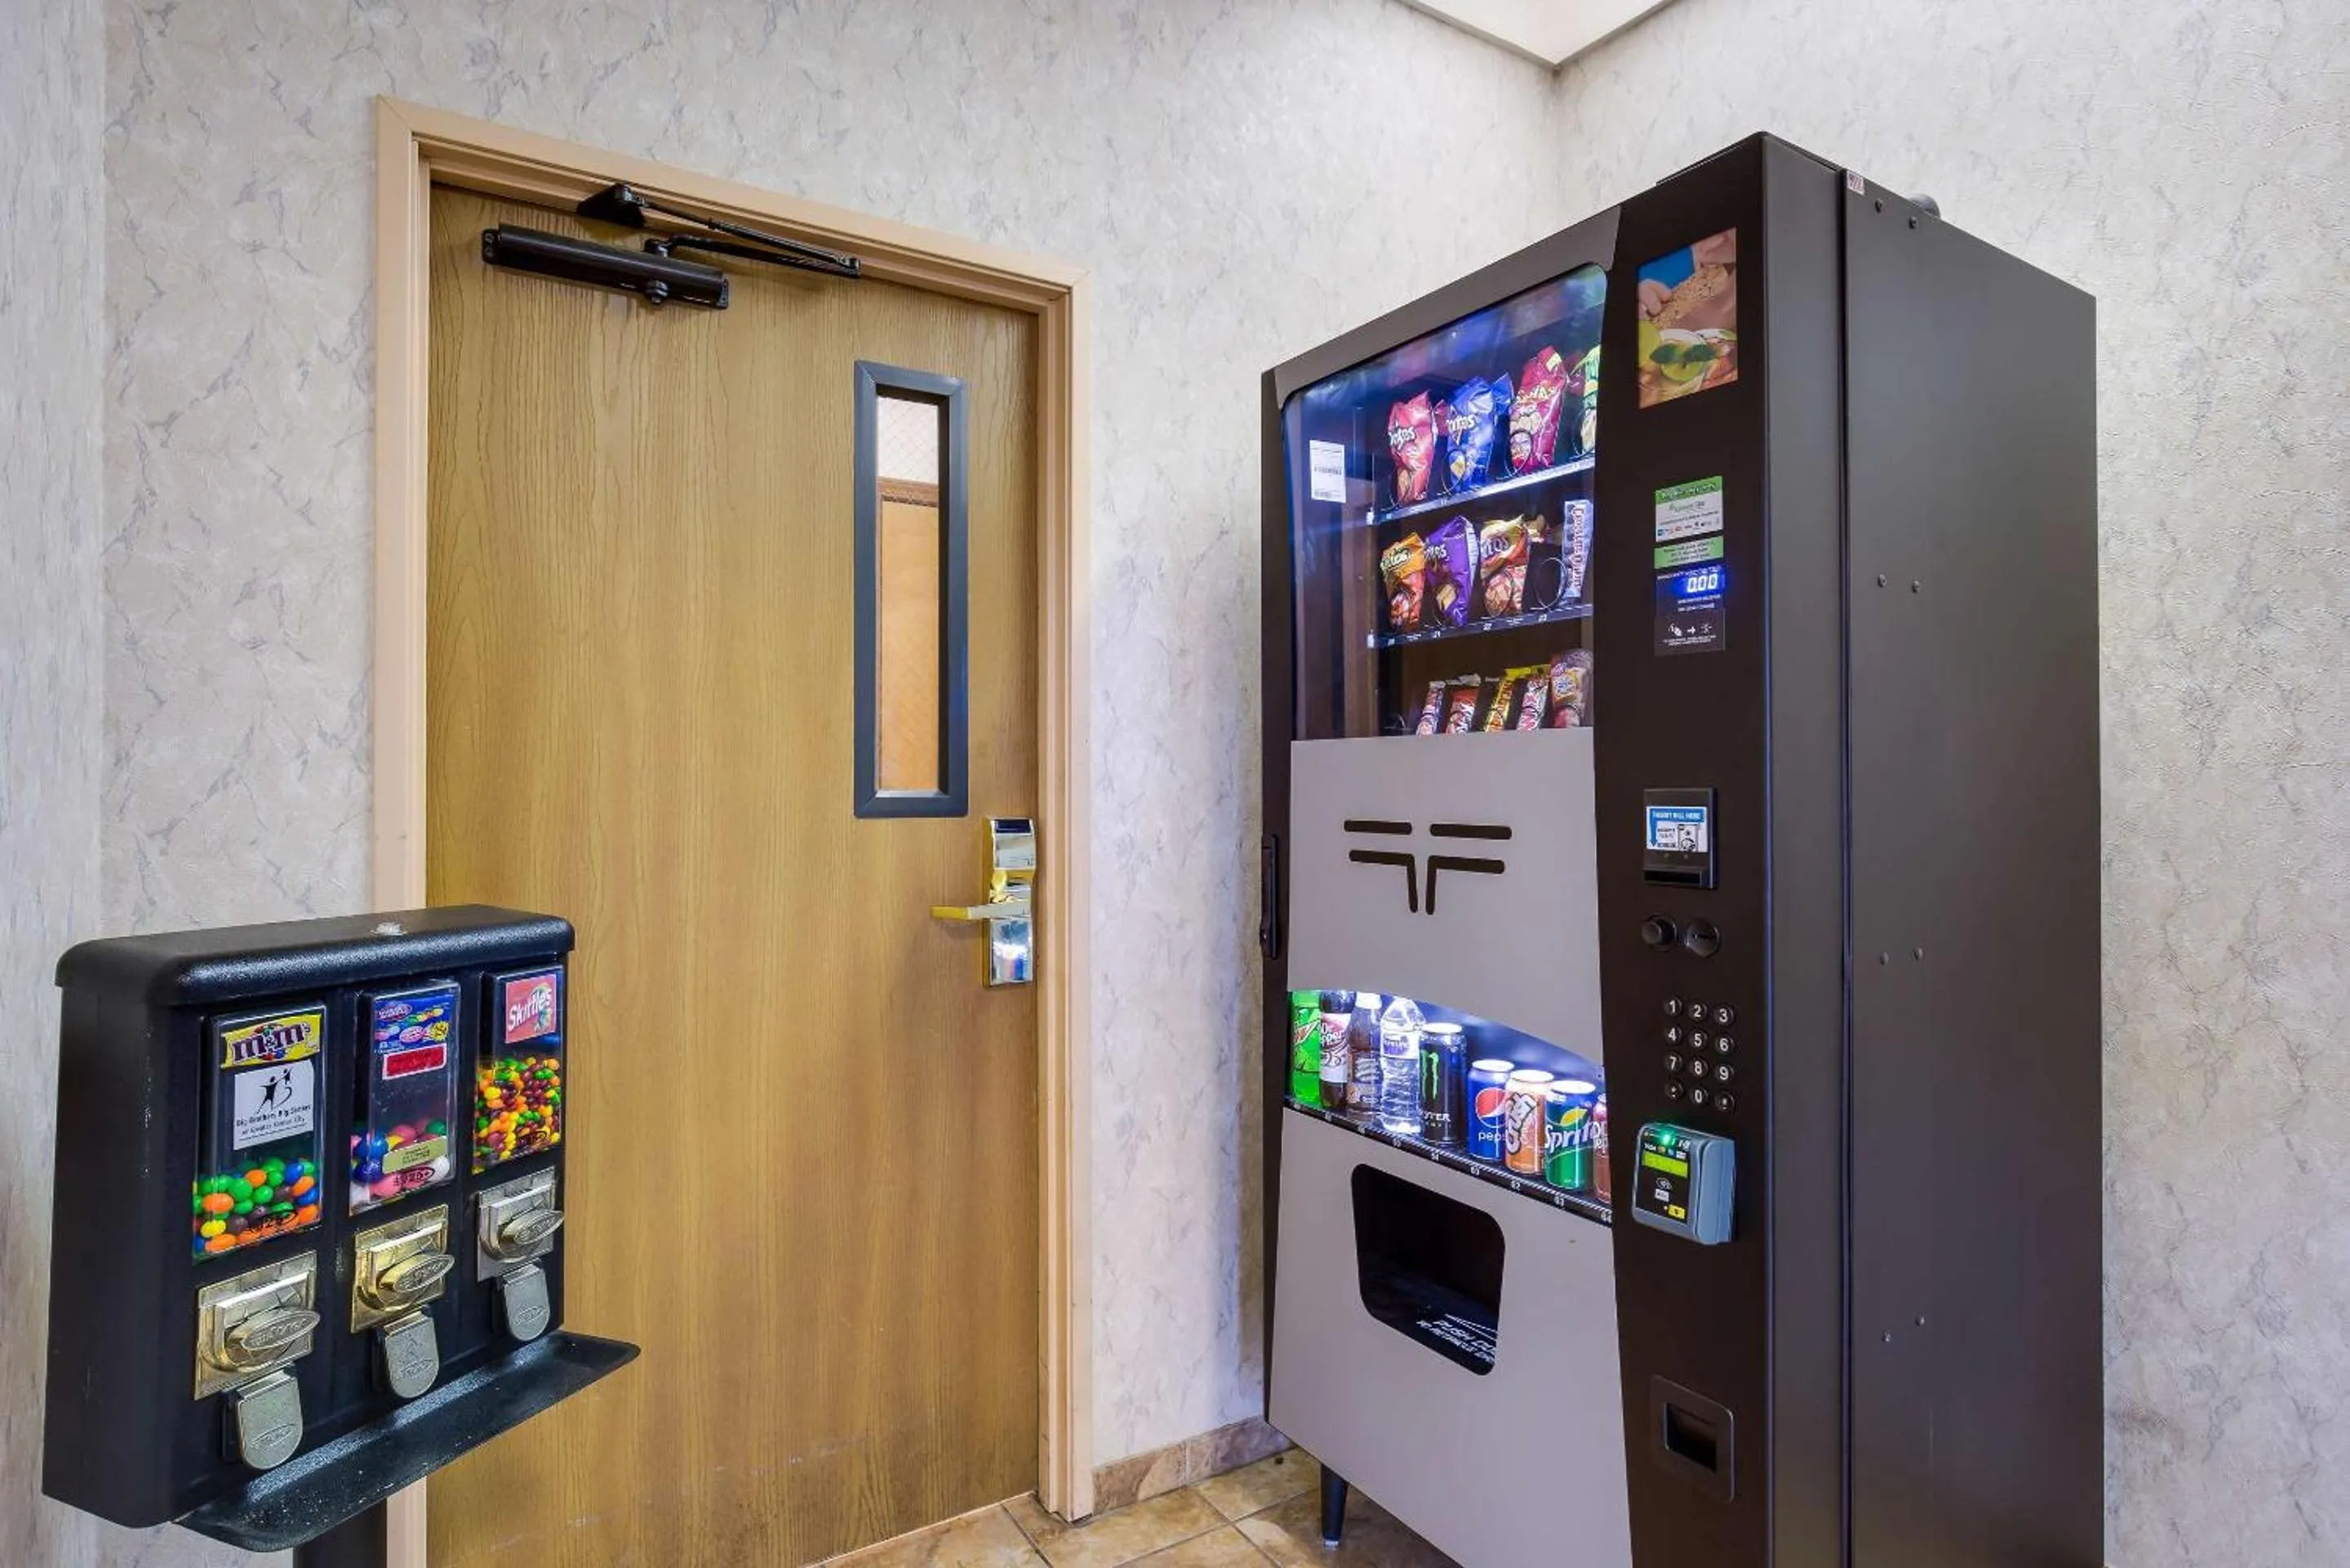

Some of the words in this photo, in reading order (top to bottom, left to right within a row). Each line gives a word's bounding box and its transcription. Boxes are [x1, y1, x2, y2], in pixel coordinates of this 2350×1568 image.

[509, 987, 553, 1032] Skittles
[1669, 1000, 1676, 1013] 1
[1694, 1004, 1701, 1018] 2
[1719, 1008, 1728, 1023] 3
[1668, 1027, 1677, 1042] 4
[1694, 1033, 1702, 1047] 5
[1719, 1037, 1729, 1052] 6
[1669, 1055, 1677, 1070] 7
[1694, 1060, 1703, 1075] 8
[1719, 1065, 1729, 1081] 9
[1694, 1089, 1703, 1104] 0
[1544, 1122, 1593, 1153] Sprit
